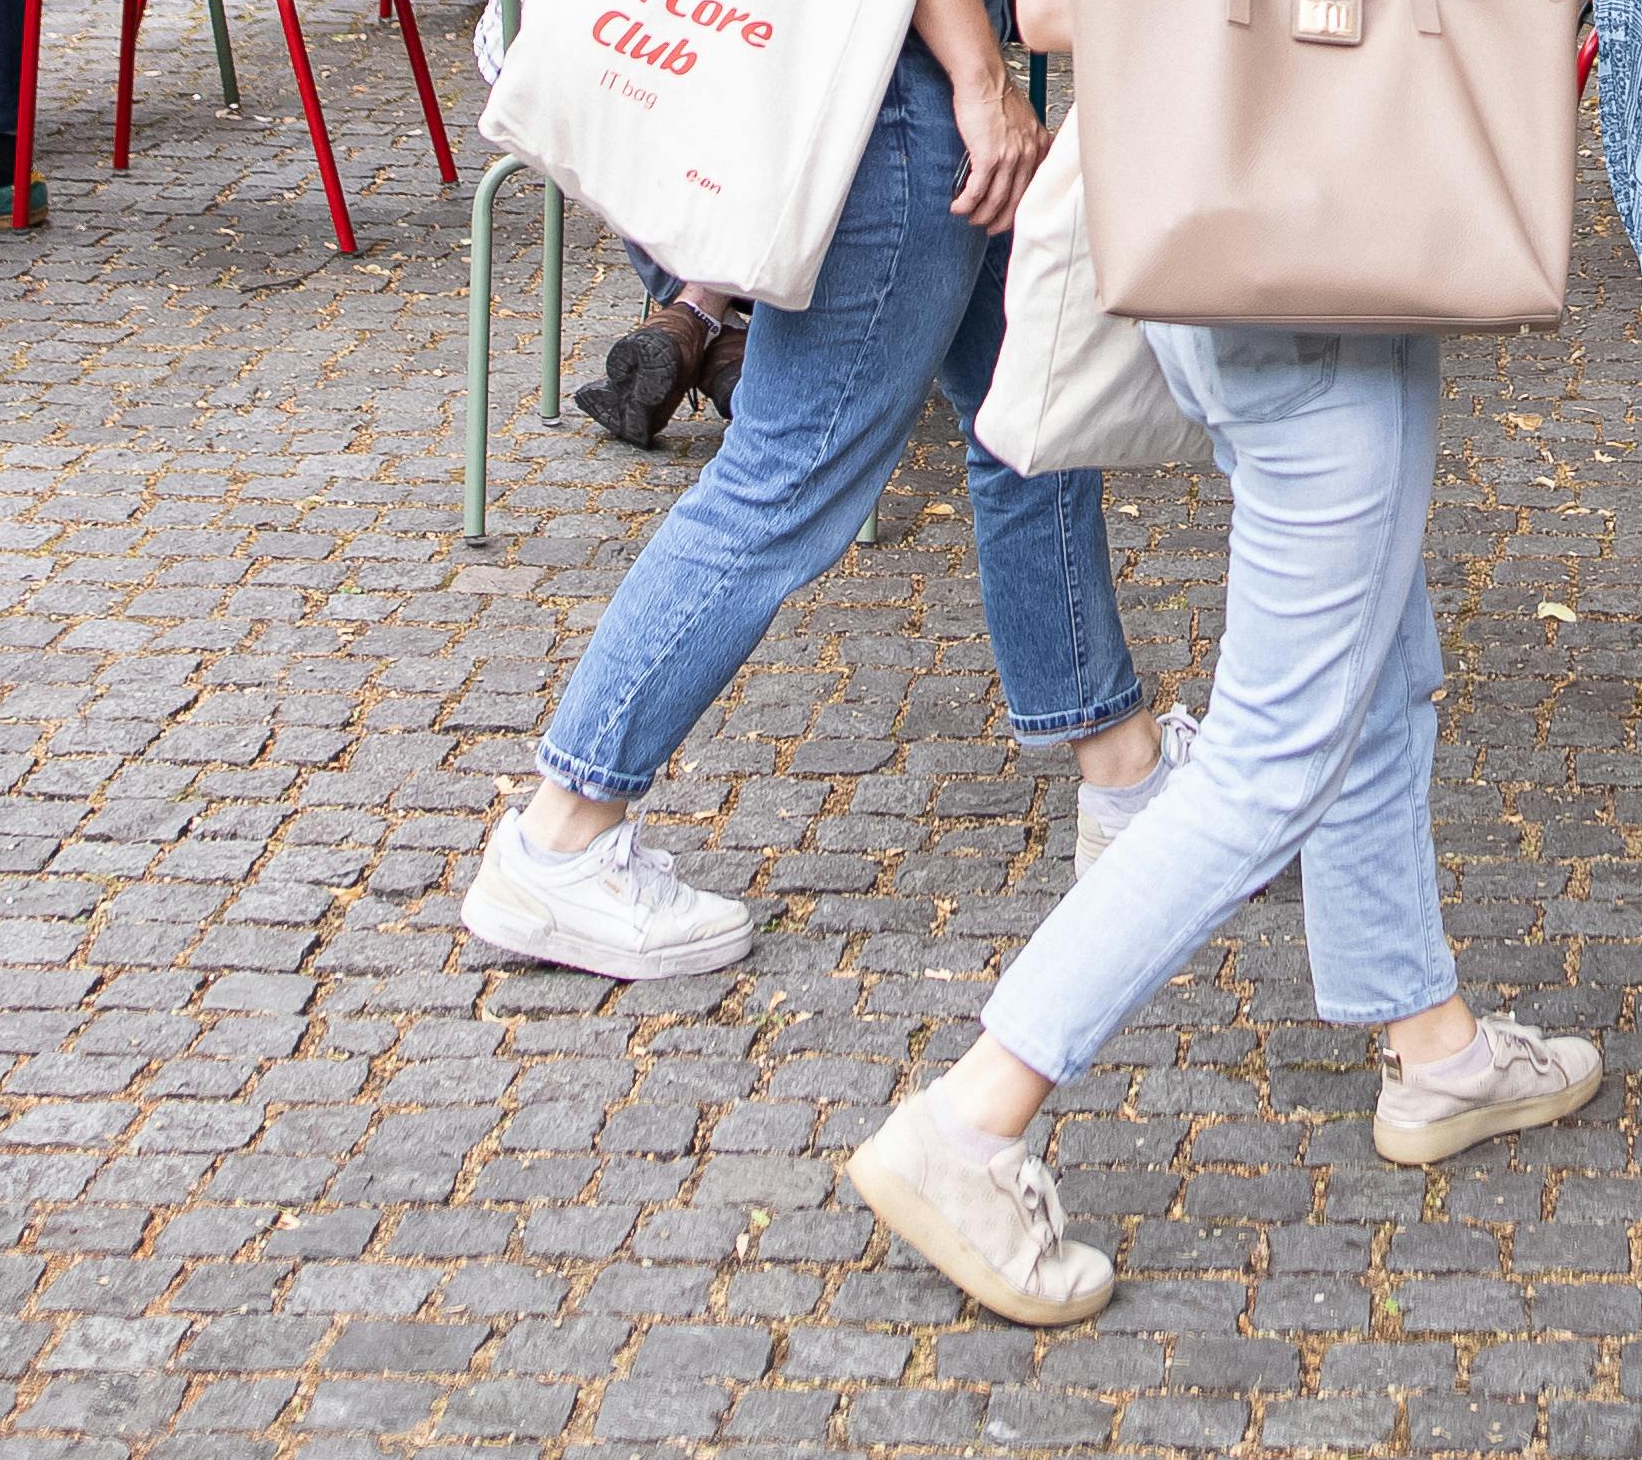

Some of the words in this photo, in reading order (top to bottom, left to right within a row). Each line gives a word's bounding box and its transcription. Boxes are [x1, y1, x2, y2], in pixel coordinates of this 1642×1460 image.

[592, 10, 698, 76] Club
[599, 68, 622, 90] IT
[621, 78, 659, 111] bag
